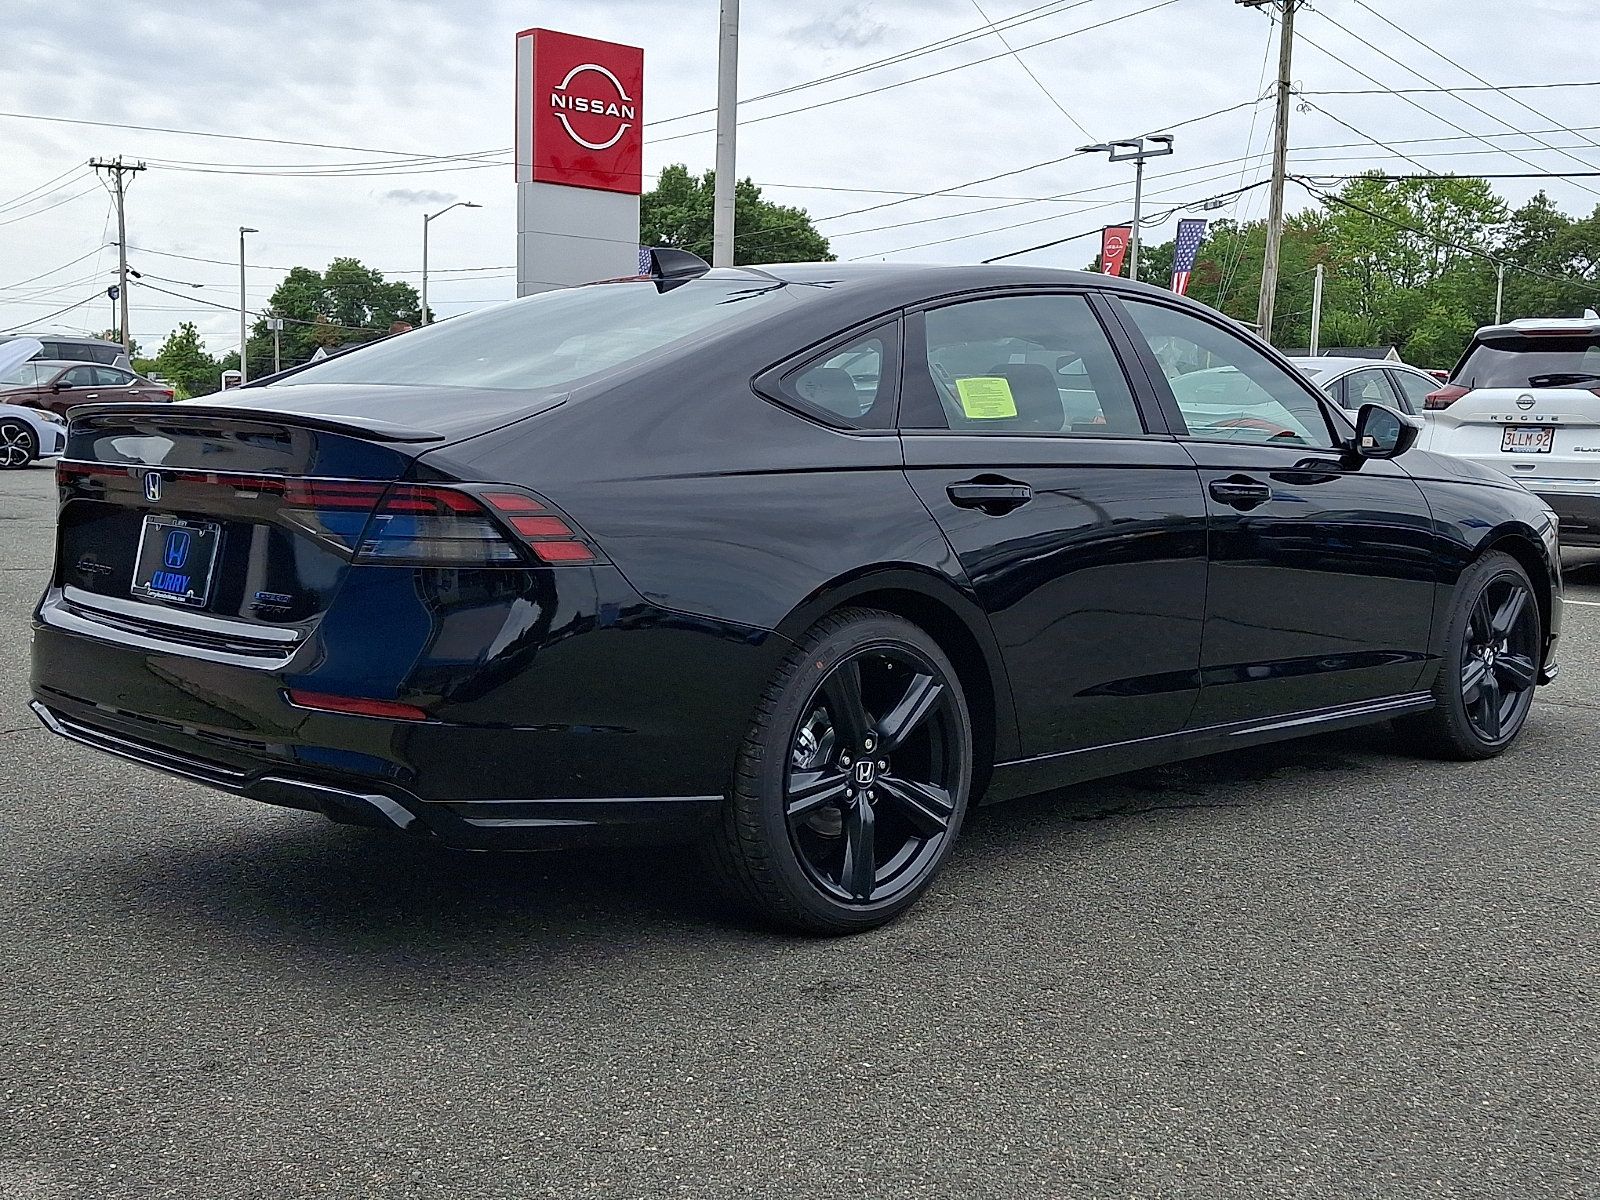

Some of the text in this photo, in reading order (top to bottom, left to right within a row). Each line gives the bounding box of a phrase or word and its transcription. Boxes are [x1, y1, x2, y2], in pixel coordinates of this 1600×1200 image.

[551, 93, 635, 120] NISSAN
[1505, 433, 1550, 447] 3LLM 92
[151, 571, 191, 592] CURRY
